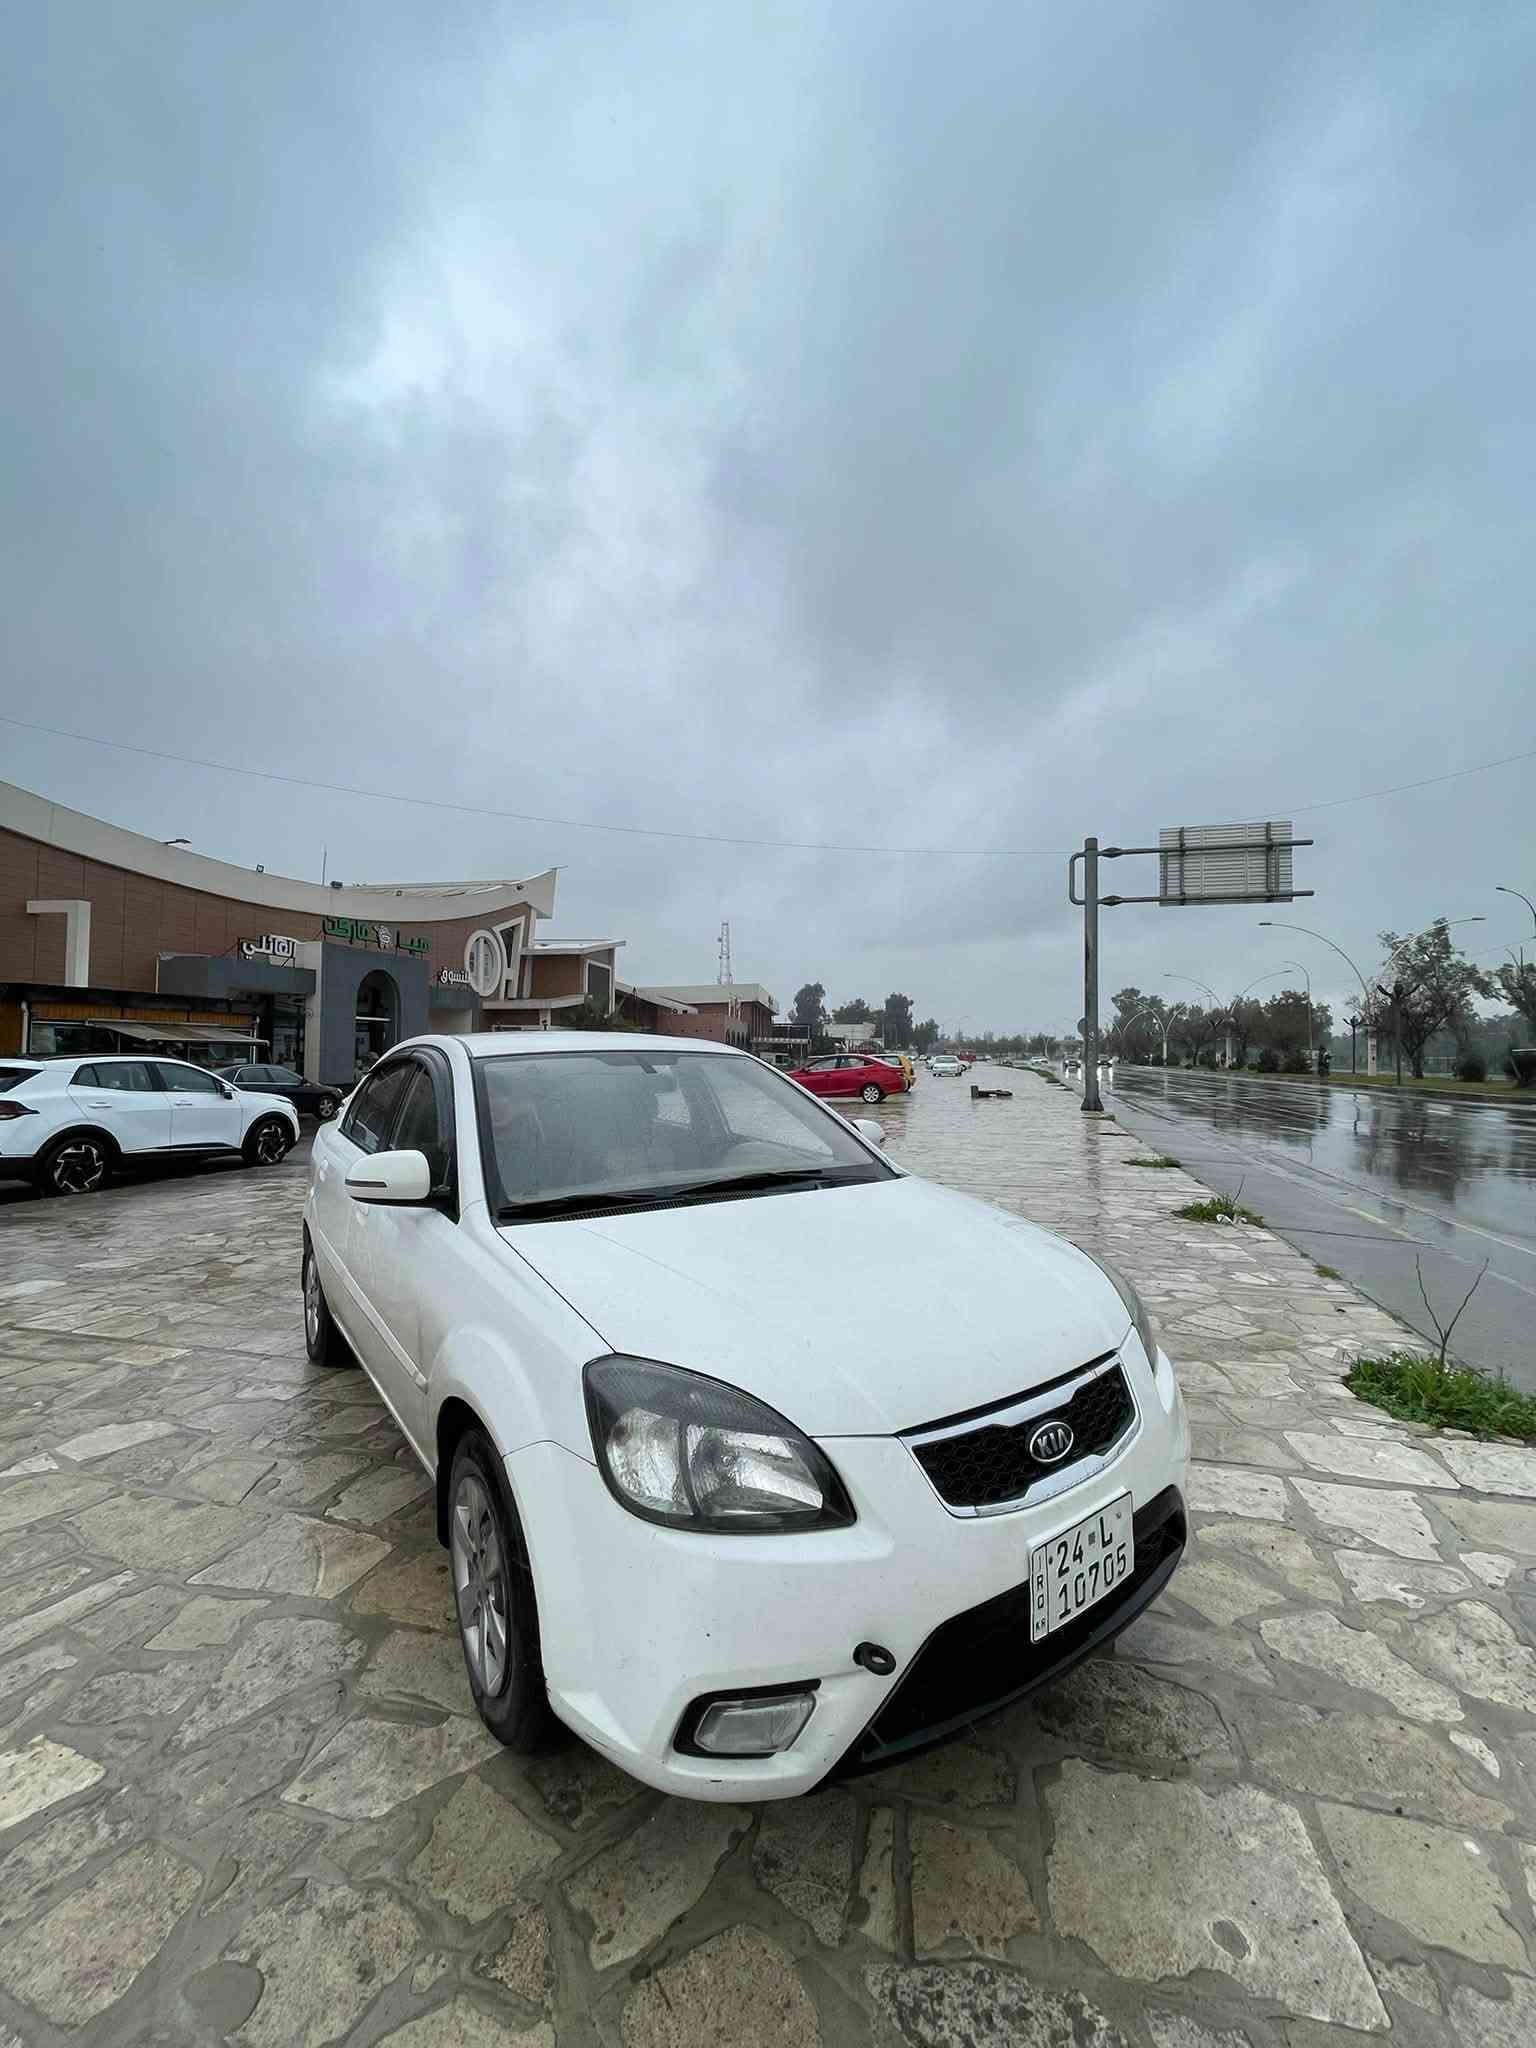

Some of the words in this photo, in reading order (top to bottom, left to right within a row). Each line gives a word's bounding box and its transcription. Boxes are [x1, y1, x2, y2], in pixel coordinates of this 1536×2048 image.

[1037, 1427, 1068, 1458] KIA
[1056, 1530, 1084, 1578] 24
[1099, 1516, 1113, 1548] L
[1058, 1542, 1127, 1620] 10705
